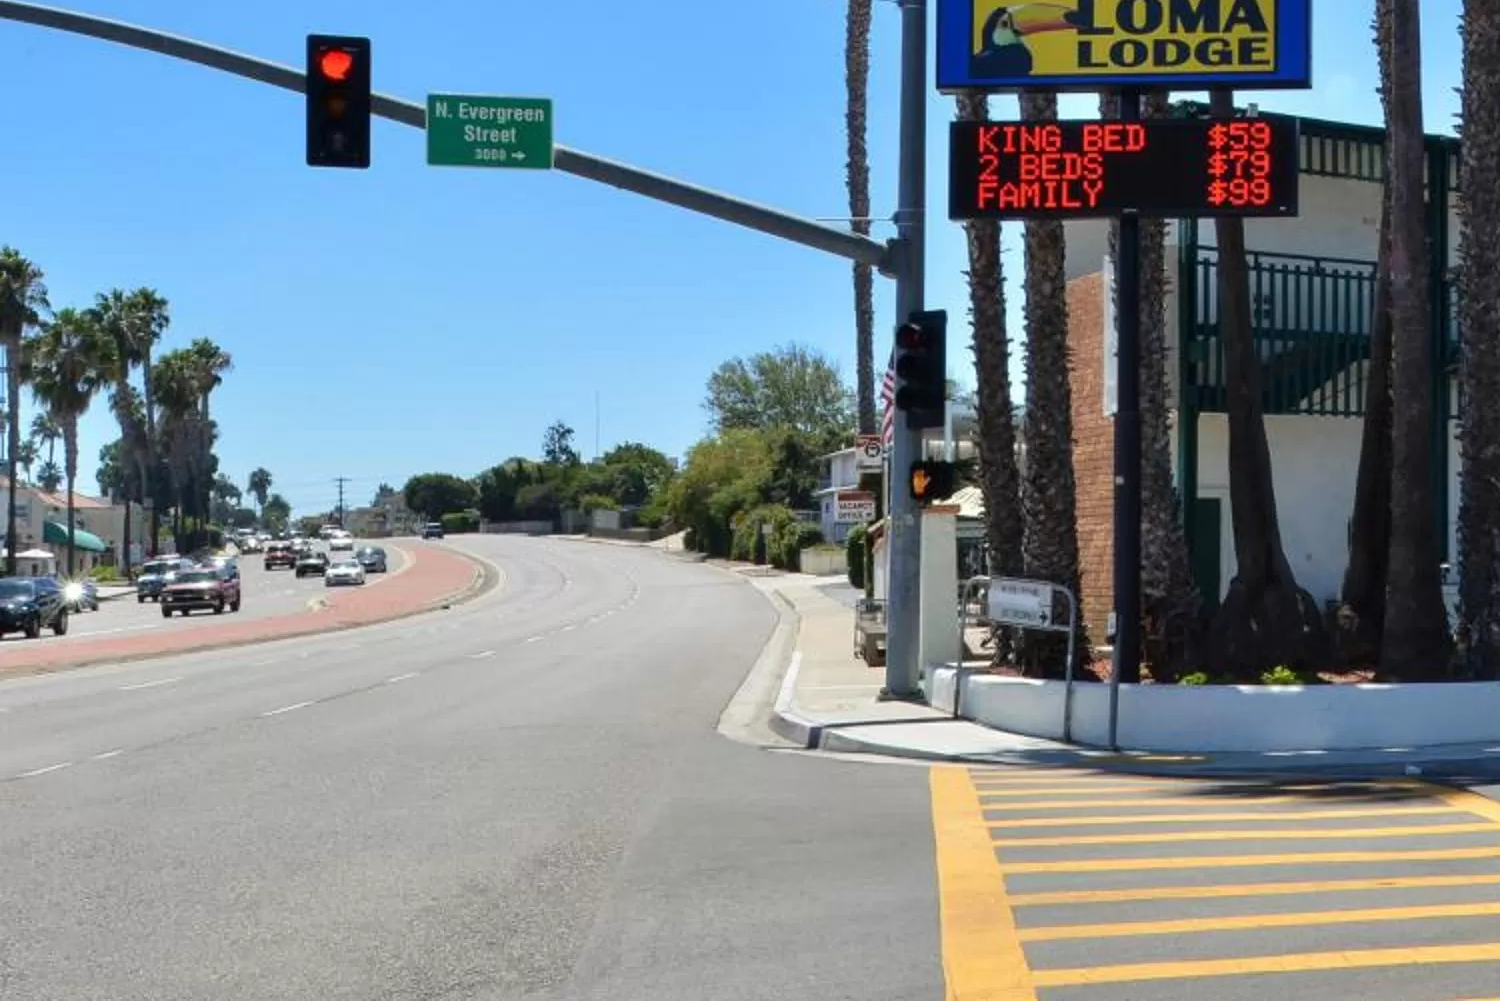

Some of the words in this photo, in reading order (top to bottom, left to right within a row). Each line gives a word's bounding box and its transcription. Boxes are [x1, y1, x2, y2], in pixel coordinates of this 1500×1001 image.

[1077, 37, 1271, 68] LODGE
[435, 101, 453, 119] N.
[459, 102, 545, 124] Evergreen
[464, 124, 517, 143] Street
[978, 126, 1062, 152] KING
[1082, 124, 1145, 151] BED
[1207, 122, 1271, 150] $59
[978, 154, 999, 180] 2
[1019, 152, 1103, 180] BEDS
[1207, 150, 1271, 178] $79
[978, 180, 1104, 209] FAMILY
[1207, 178, 1271, 206] $99
